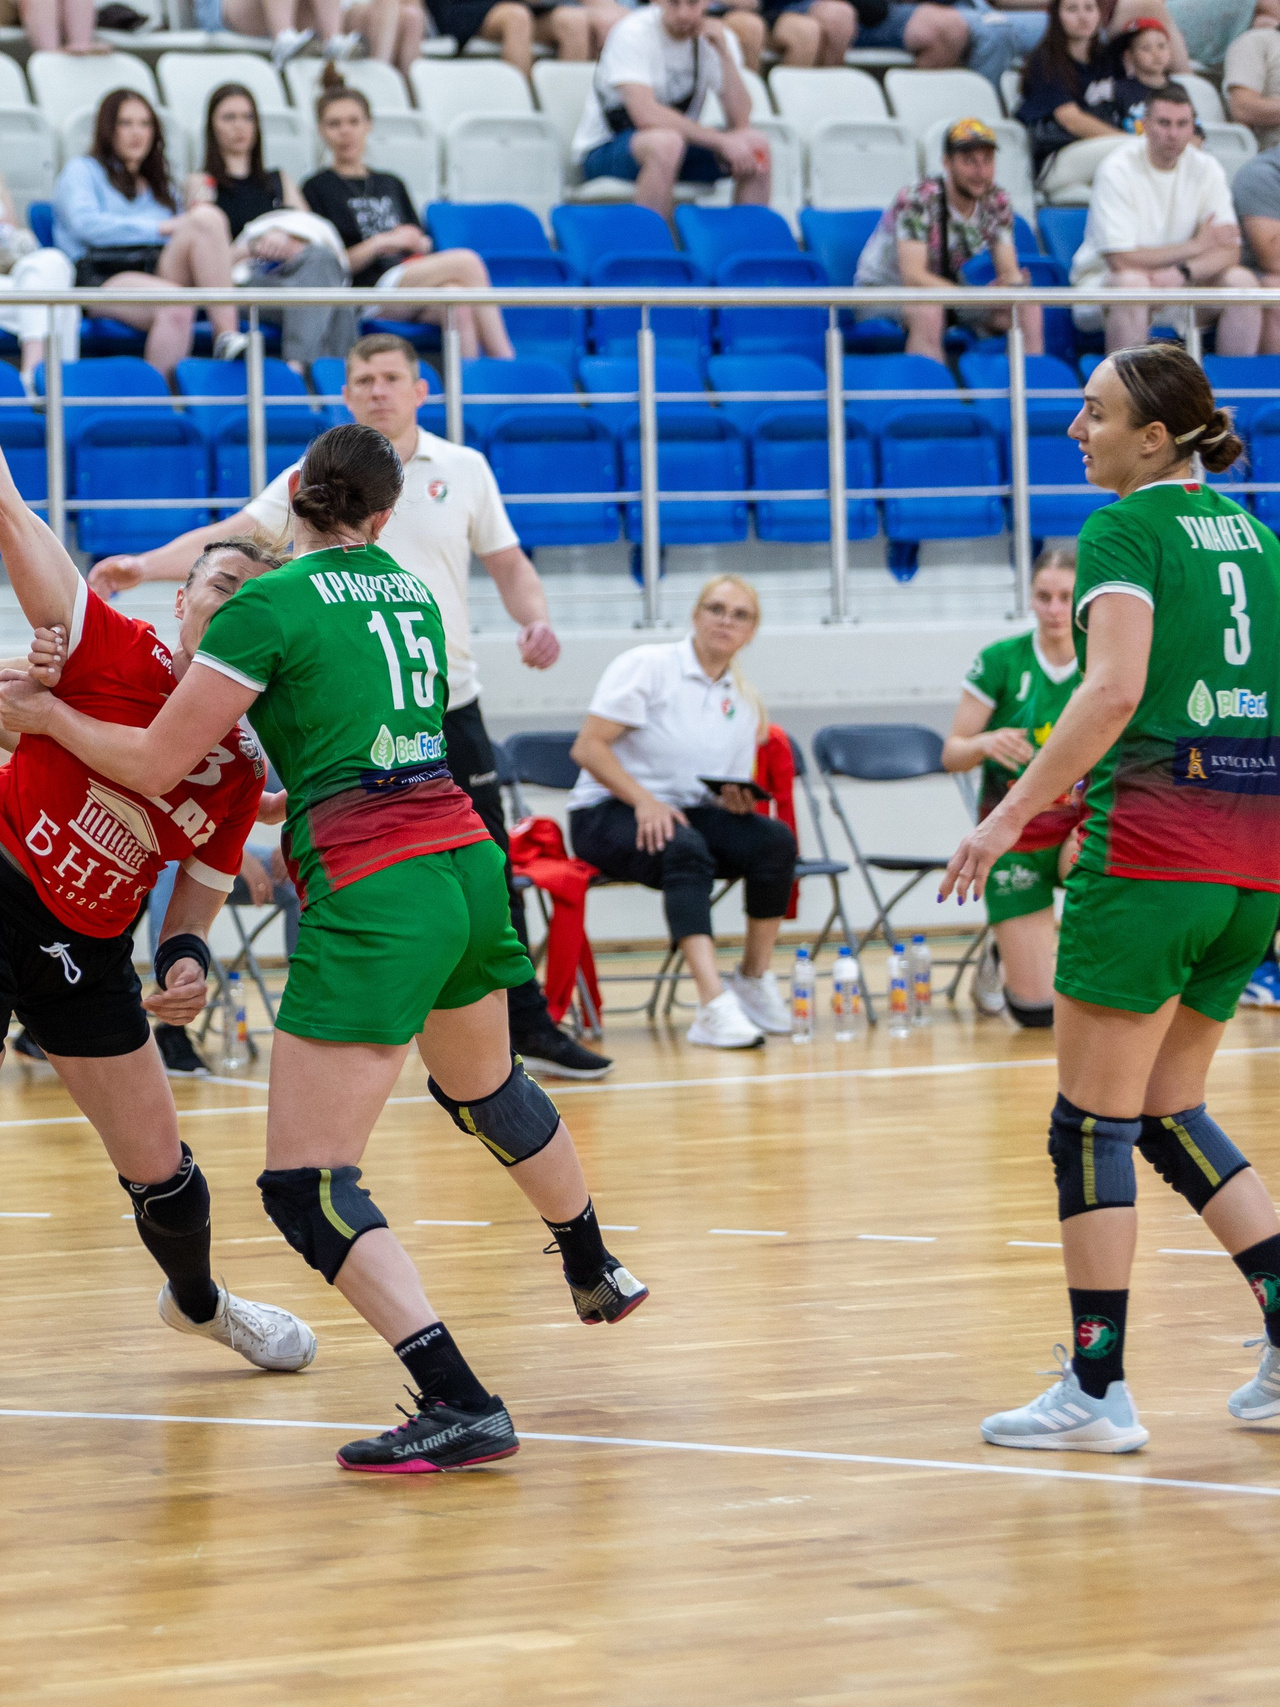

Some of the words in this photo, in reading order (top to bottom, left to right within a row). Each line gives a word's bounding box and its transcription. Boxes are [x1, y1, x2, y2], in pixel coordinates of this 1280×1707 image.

[1175, 513, 1263, 553] УМАНЕЦ
[1218, 562, 1251, 665] 3
[151, 644, 172, 675] Kem
[367, 611, 438, 709] 15
[55, 884, 98, 909] 1920
[397, 1328, 441, 1357] empa
